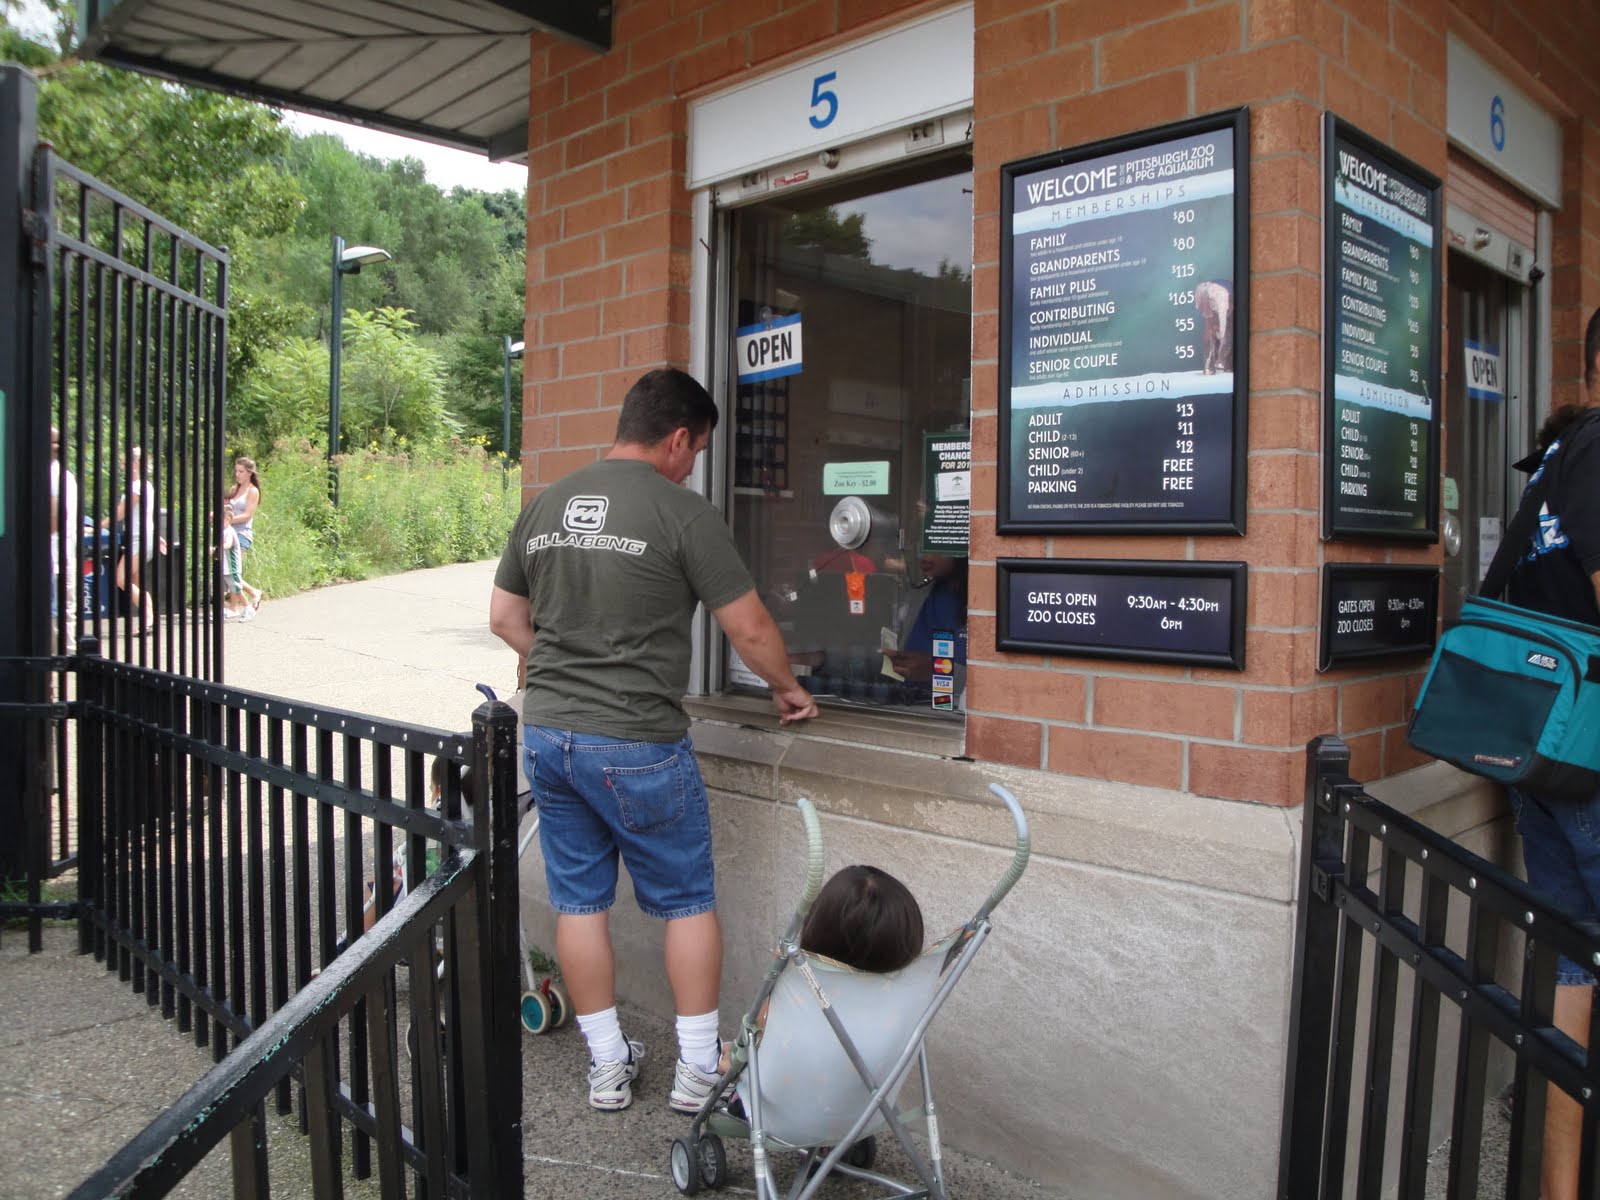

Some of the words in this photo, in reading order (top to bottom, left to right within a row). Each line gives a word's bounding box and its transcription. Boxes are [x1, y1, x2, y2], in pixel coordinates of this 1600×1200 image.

[809, 71, 838, 129] 5
[1490, 95, 1505, 151] 6
[1126, 151, 1190, 173] PITTSBURGH
[1191, 144, 1215, 159] ZOO
[1126, 174, 1133, 184] &
[1135, 169, 1155, 182] PPG
[1157, 156, 1214, 177] AQUARIUM
[1339, 150, 1388, 197] WELCOME
[1027, 165, 1117, 205] WELCOME
[1052, 185, 1185, 222] MEMBERSHIPS
[1030, 233, 1067, 251] FAMILY
[1173, 209, 1195, 224] $80
[1342, 213, 1363, 233] FAMILY
[1030, 249, 1120, 275] GRANDPARENTS
[1173, 236, 1195, 251] $80
[1342, 240, 1389, 272] GRANDPARENTS
[1172, 263, 1195, 278] $115
[1342, 267, 1362, 286] FAMILY
[1363, 276, 1378, 293] PLUS
[1030, 283, 1066, 300] FAMILY
[1070, 278, 1096, 294] PLUS
[1168, 290, 1195, 306] $165
[1029, 301, 1115, 324] CONTRIBUTING
[1342, 295, 1386, 322] CONTRIBUTING
[1175, 318, 1195, 332] $55
[1029, 330, 1093, 349] INDIVIDUAL
[1342, 322, 1376, 345] INDIVIDUAL
[747, 331, 793, 368] OPEN
[1175, 345, 1195, 359] $55
[1029, 358, 1070, 374] SENIOR
[1073, 353, 1118, 369] COUPLE
[1342, 349, 1365, 369] SENIOR
[1365, 355, 1388, 375] COUPLE
[1472, 354, 1498, 388] OPEN
[1062, 379, 1170, 400] ADMISSION
[1359, 386, 1409, 410] ADMISSION
[1177, 404, 1194, 417] $13
[1341, 408, 1361, 424] ADULT
[1028, 413, 1063, 427] ADULT
[1178, 422, 1194, 435] $11
[1341, 426, 1360, 442] CHILD
[1028, 430, 1060, 444] CHILD
[1028, 447, 1069, 460] SENIOR
[1176, 440, 1194, 454] $12
[1341, 445, 1364, 460] SENIOR
[940, 461, 956, 470] FOR
[1028, 464, 1060, 477] CHILD
[1163, 458, 1194, 473] FREE
[1341, 463, 1359, 478] CHILD
[1028, 480, 1077, 493] PARKING
[1163, 477, 1194, 490] FREE
[1404, 472, 1418, 485] FREE
[1340, 481, 1368, 497] PARKING
[1404, 488, 1418, 502] FREE
[526, 532, 647, 555] BILLABONG
[1028, 591, 1062, 605] GATES
[1065, 593, 1097, 606] OPEN
[1127, 596, 1167, 610] 9:30AM
[1178, 598, 1219, 612] 4:30PM
[1338, 600, 1358, 613] GATES
[1358, 600, 1376, 613] OPEN
[1027, 610, 1051, 622] ZOO
[1055, 611, 1096, 625] CLOSES
[1160, 617, 1182, 630] 6PM
[1337, 620, 1352, 633] ZOO
[1352, 619, 1374, 632] CLOSES
